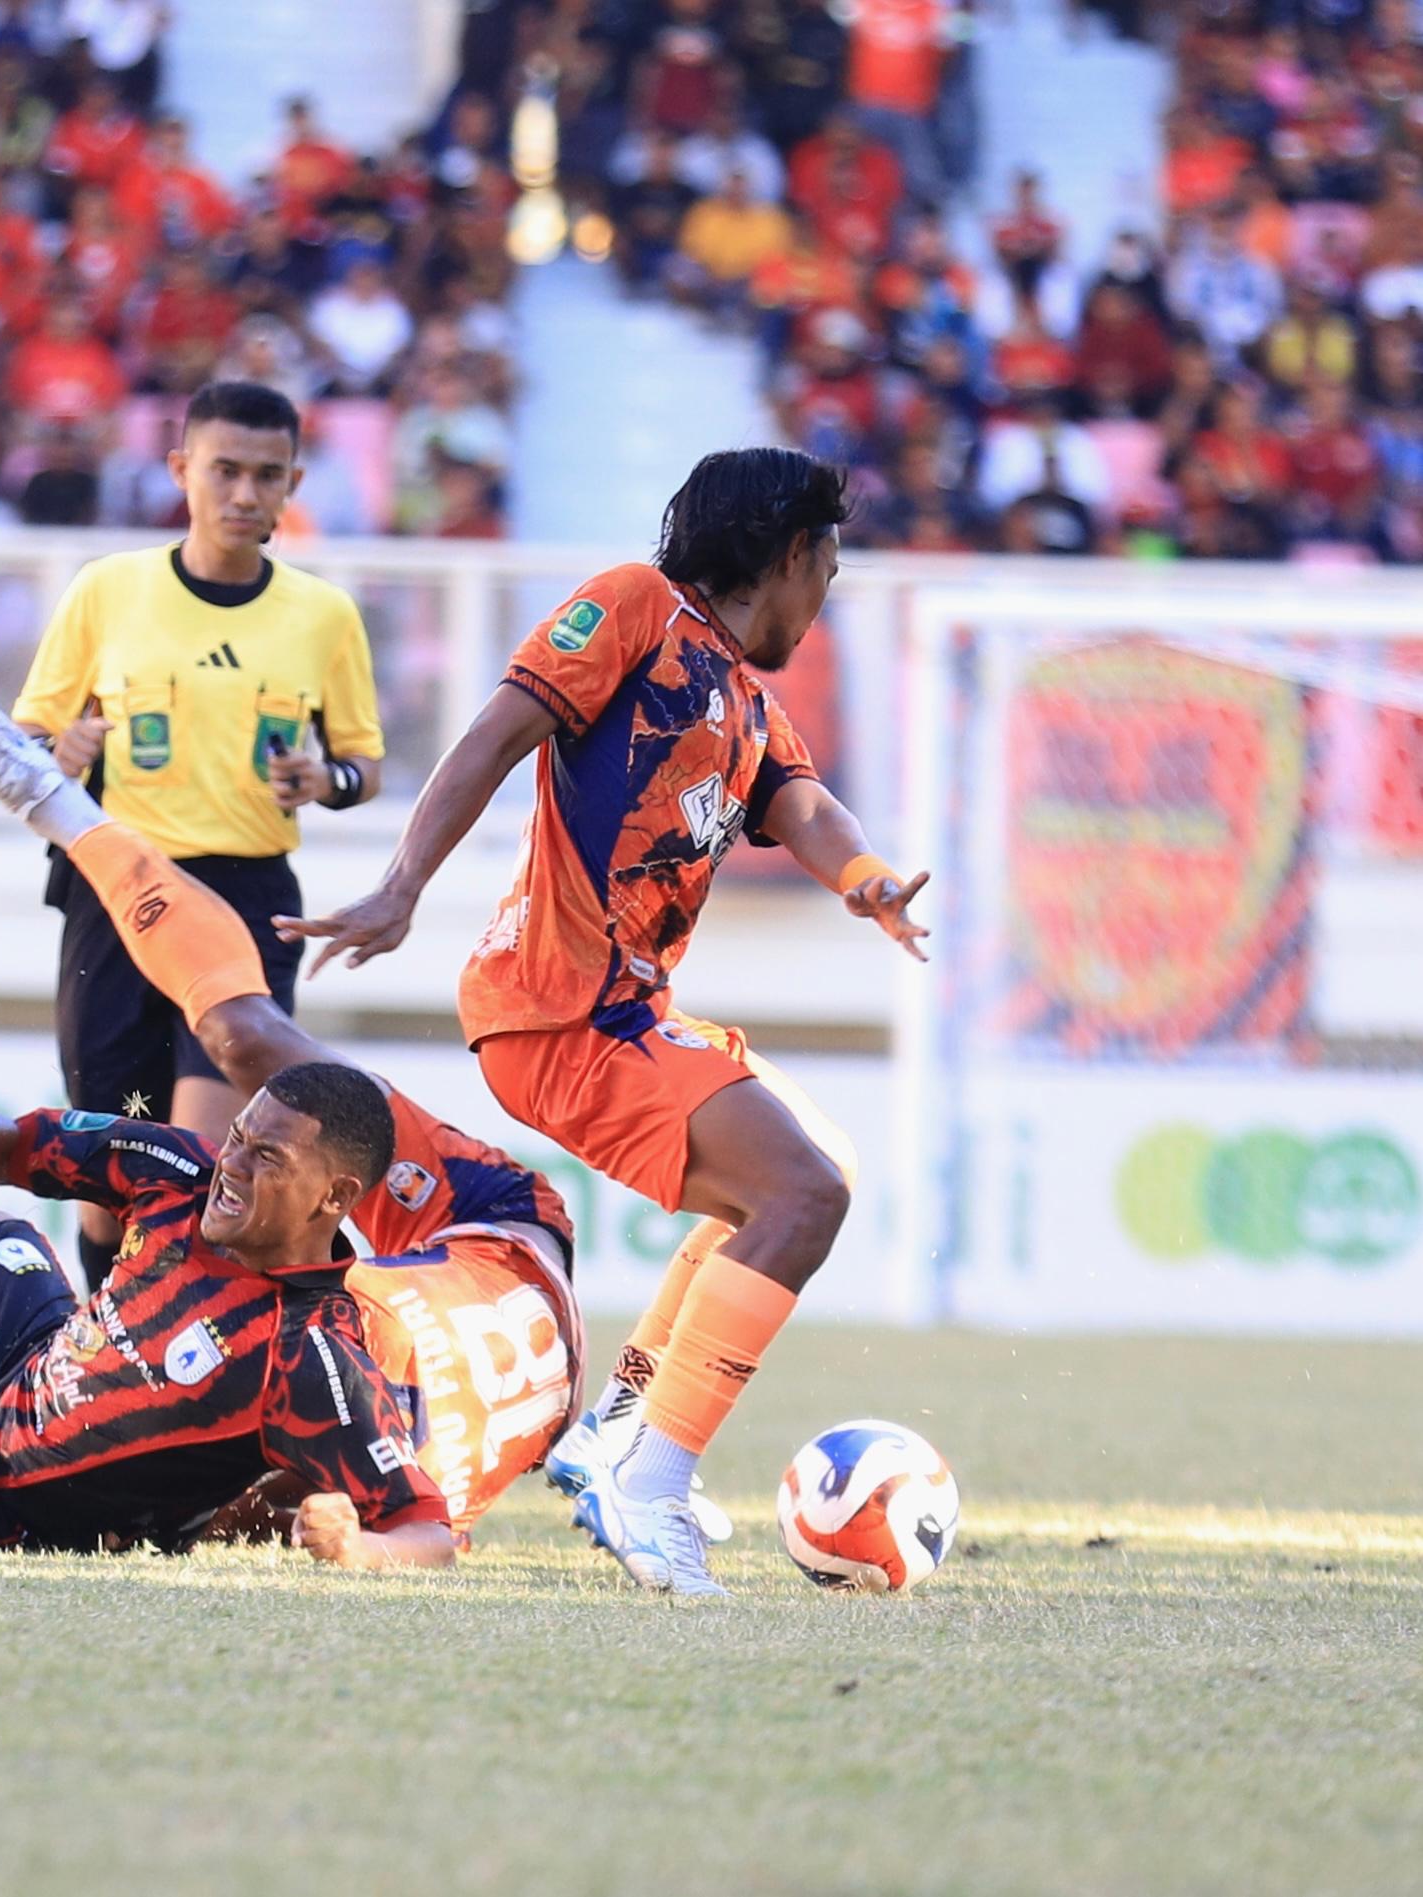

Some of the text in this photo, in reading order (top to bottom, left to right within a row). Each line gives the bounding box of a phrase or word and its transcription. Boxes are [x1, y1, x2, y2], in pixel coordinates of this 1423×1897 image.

[146, 1144, 180, 1166] LEBIH
[317, 1343, 338, 1377] LEBIH
[328, 1375, 352, 1426] BERANI
[447, 1283, 572, 1475] 18
